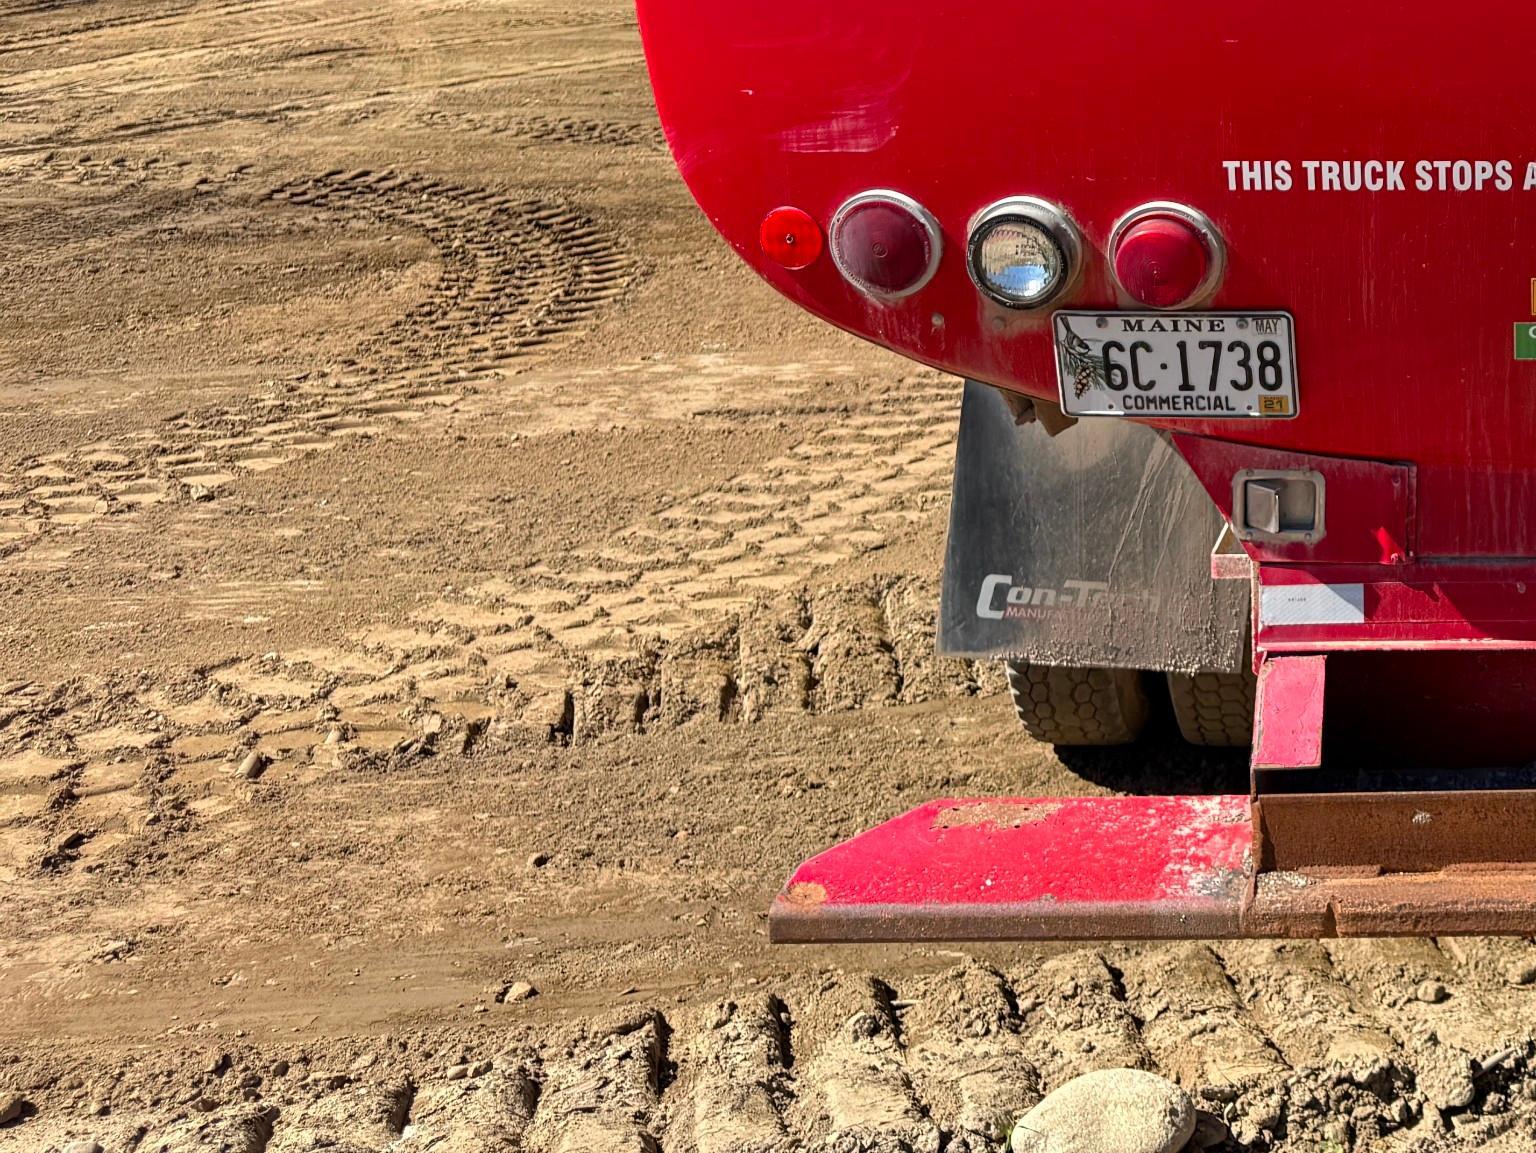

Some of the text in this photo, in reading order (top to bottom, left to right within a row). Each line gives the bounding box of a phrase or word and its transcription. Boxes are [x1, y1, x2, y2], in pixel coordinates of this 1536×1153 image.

[1222, 159, 1293, 192] THIS
[1301, 159, 1406, 192] TRUCK
[1415, 159, 1513, 192] STOPS
[1121, 319, 1226, 333] MAINE
[1255, 319, 1279, 335] MAY
[1122, 394, 1237, 412] COMMERCIAL
[1264, 399, 1283, 409] 21
